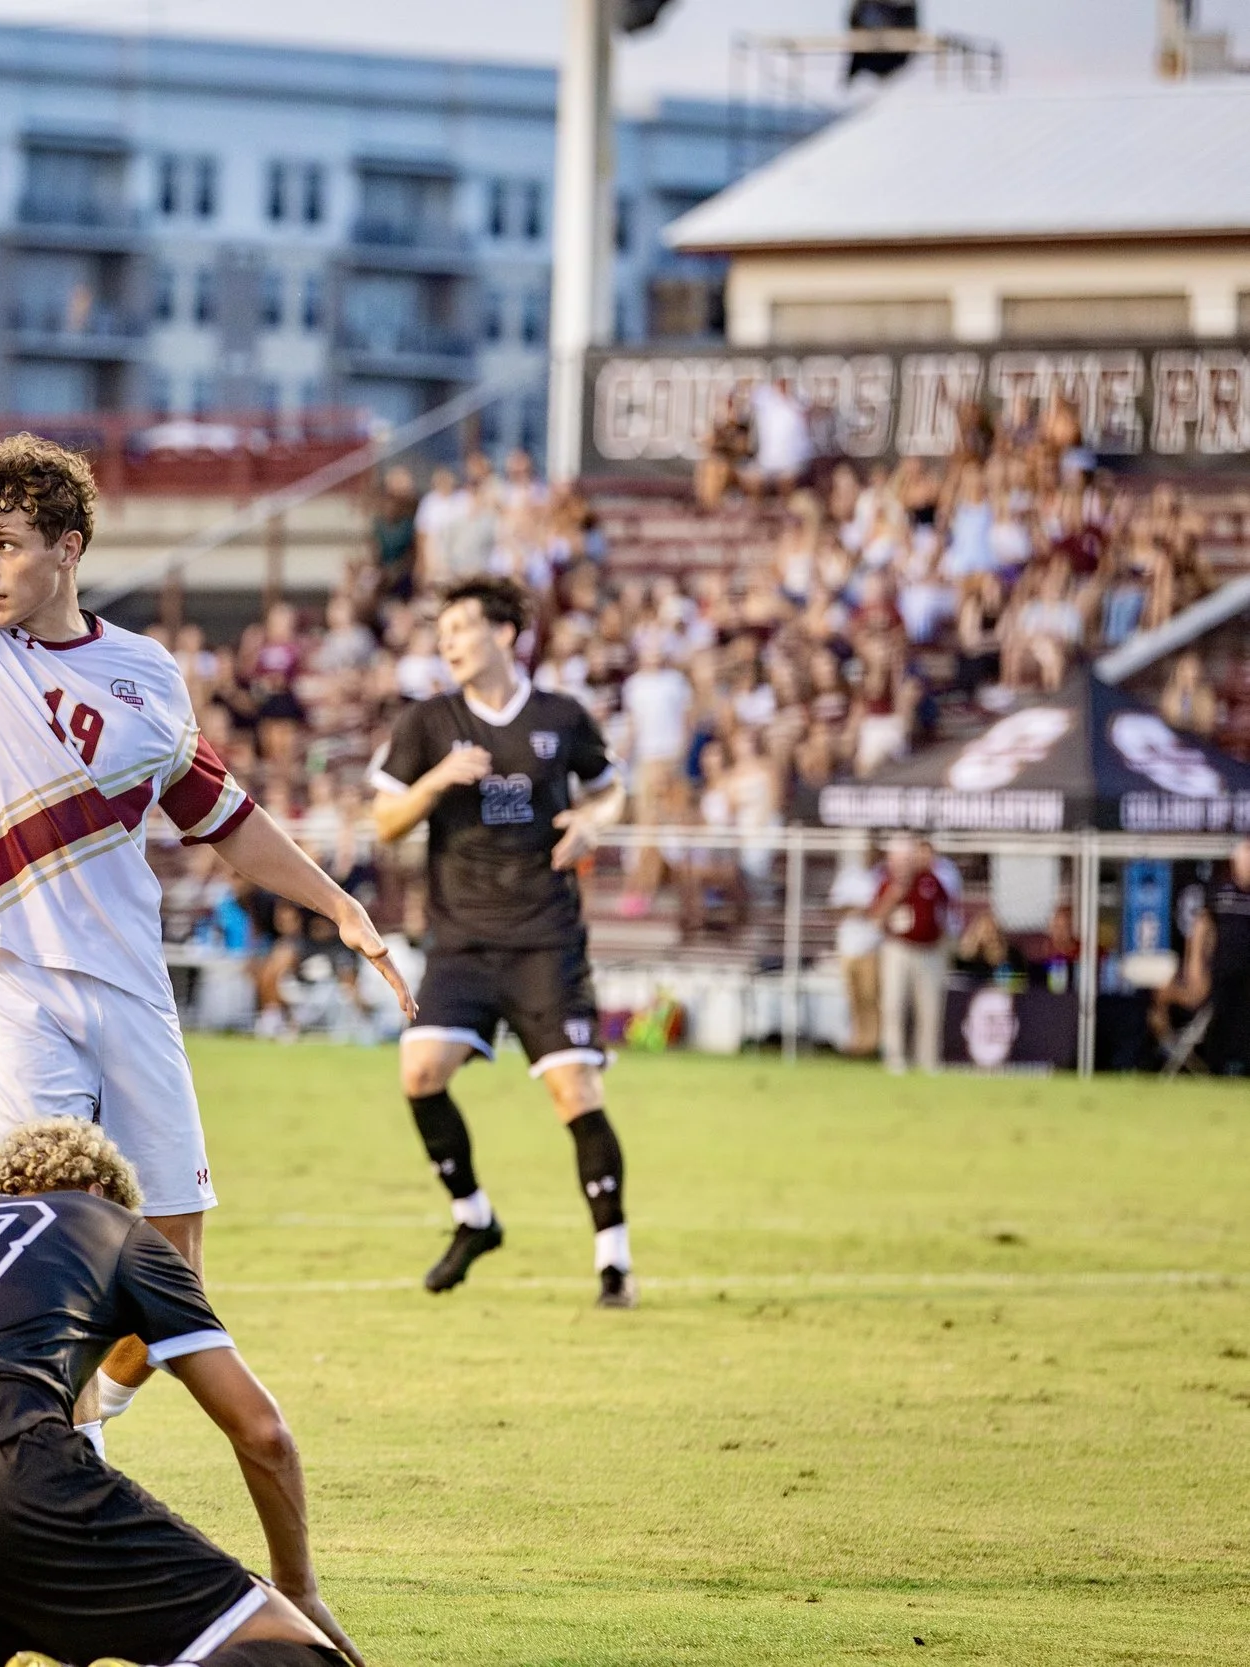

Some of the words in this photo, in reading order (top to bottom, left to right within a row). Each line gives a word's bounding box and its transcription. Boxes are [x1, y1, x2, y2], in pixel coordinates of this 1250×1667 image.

[896, 351, 986, 456] IN
[1152, 349, 1250, 454] PR
[43, 687, 105, 767] 19
[479, 772, 535, 825] 22
